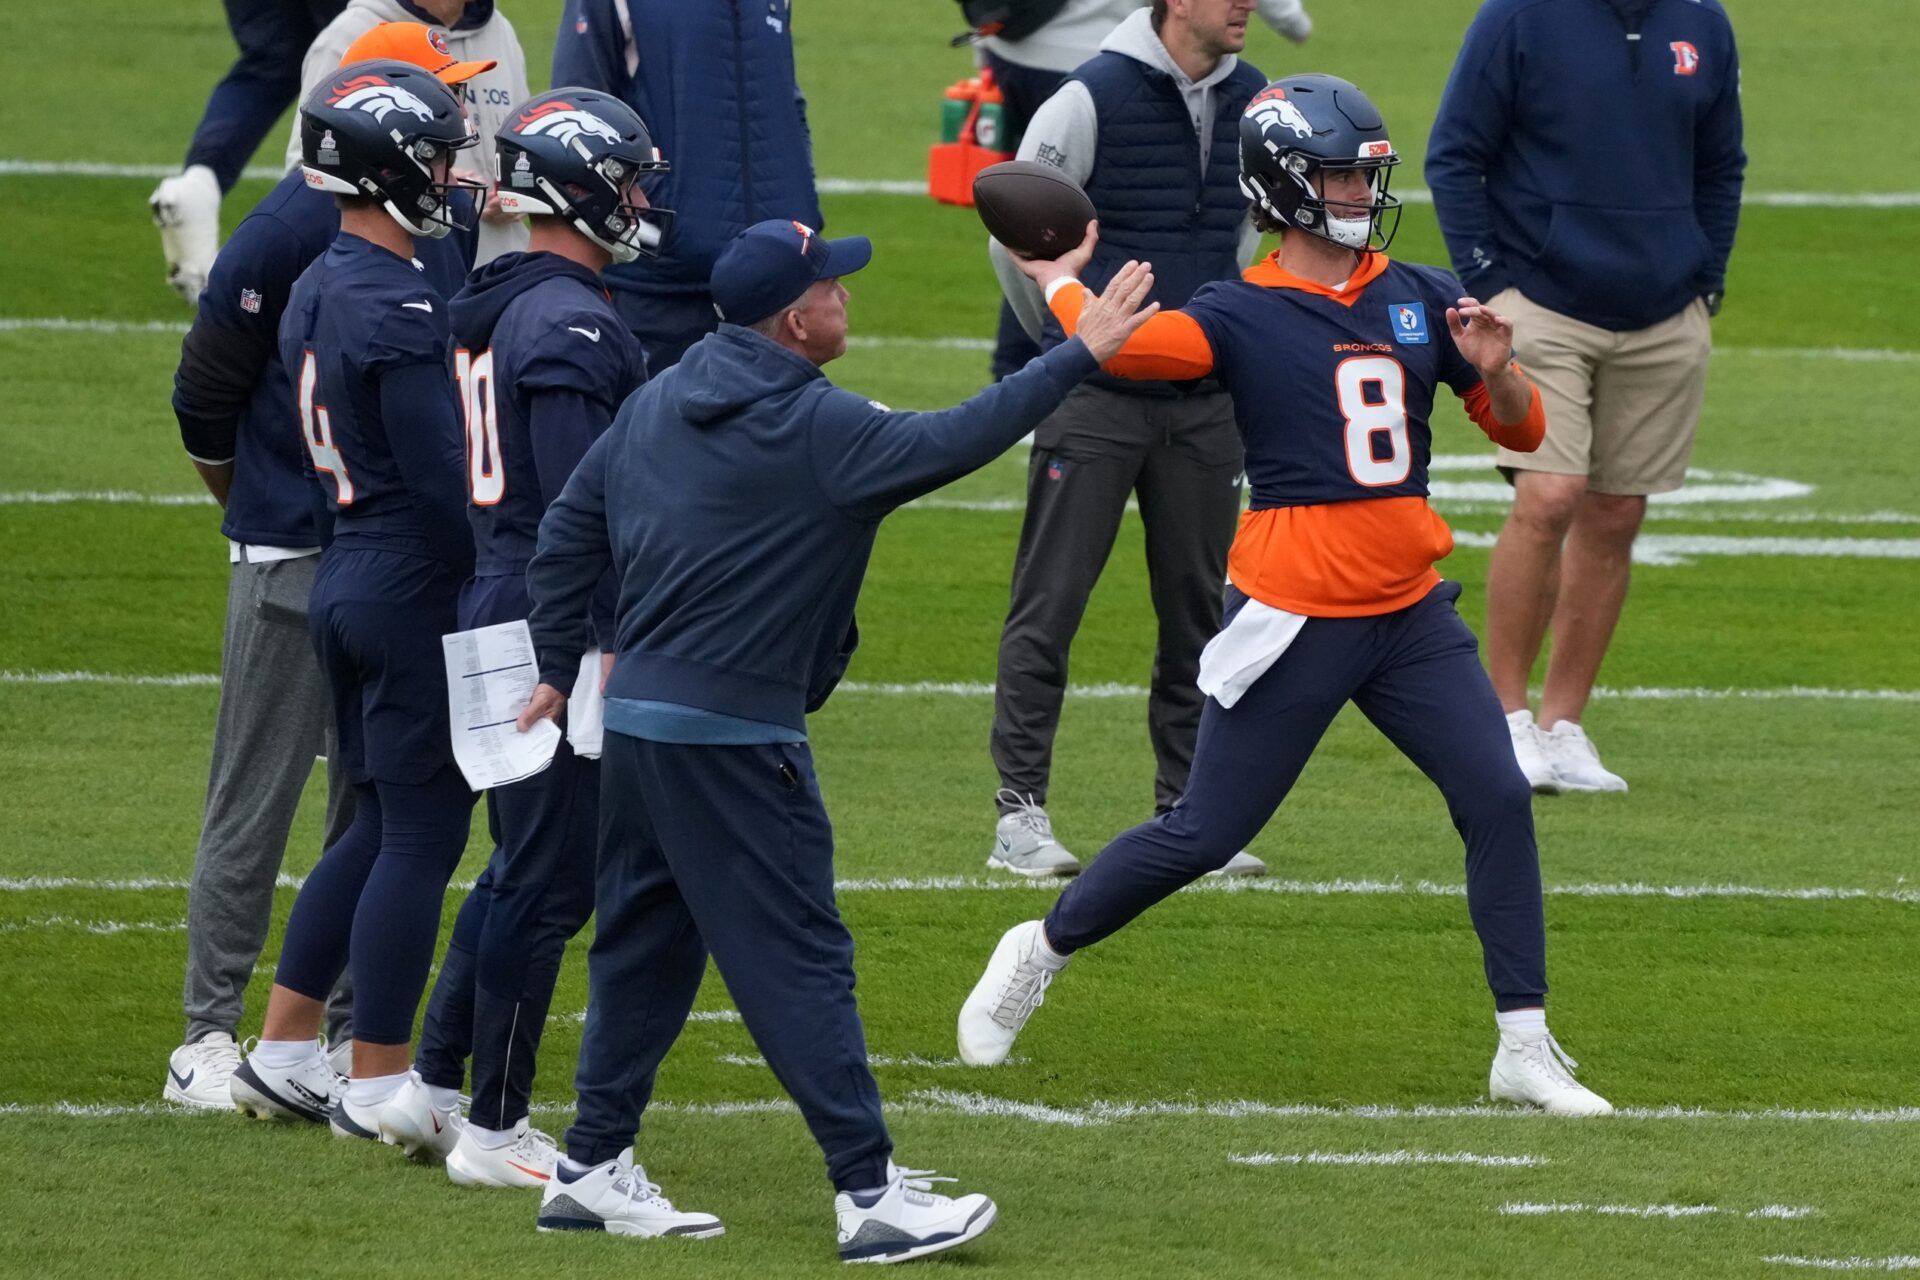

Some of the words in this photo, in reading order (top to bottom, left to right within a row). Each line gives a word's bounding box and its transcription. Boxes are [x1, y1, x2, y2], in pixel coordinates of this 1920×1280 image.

[1333, 343, 1393, 352] BRONCOS
[299, 349, 354, 504] 4
[455, 347, 505, 505] 10
[1335, 354, 1412, 488] 8
